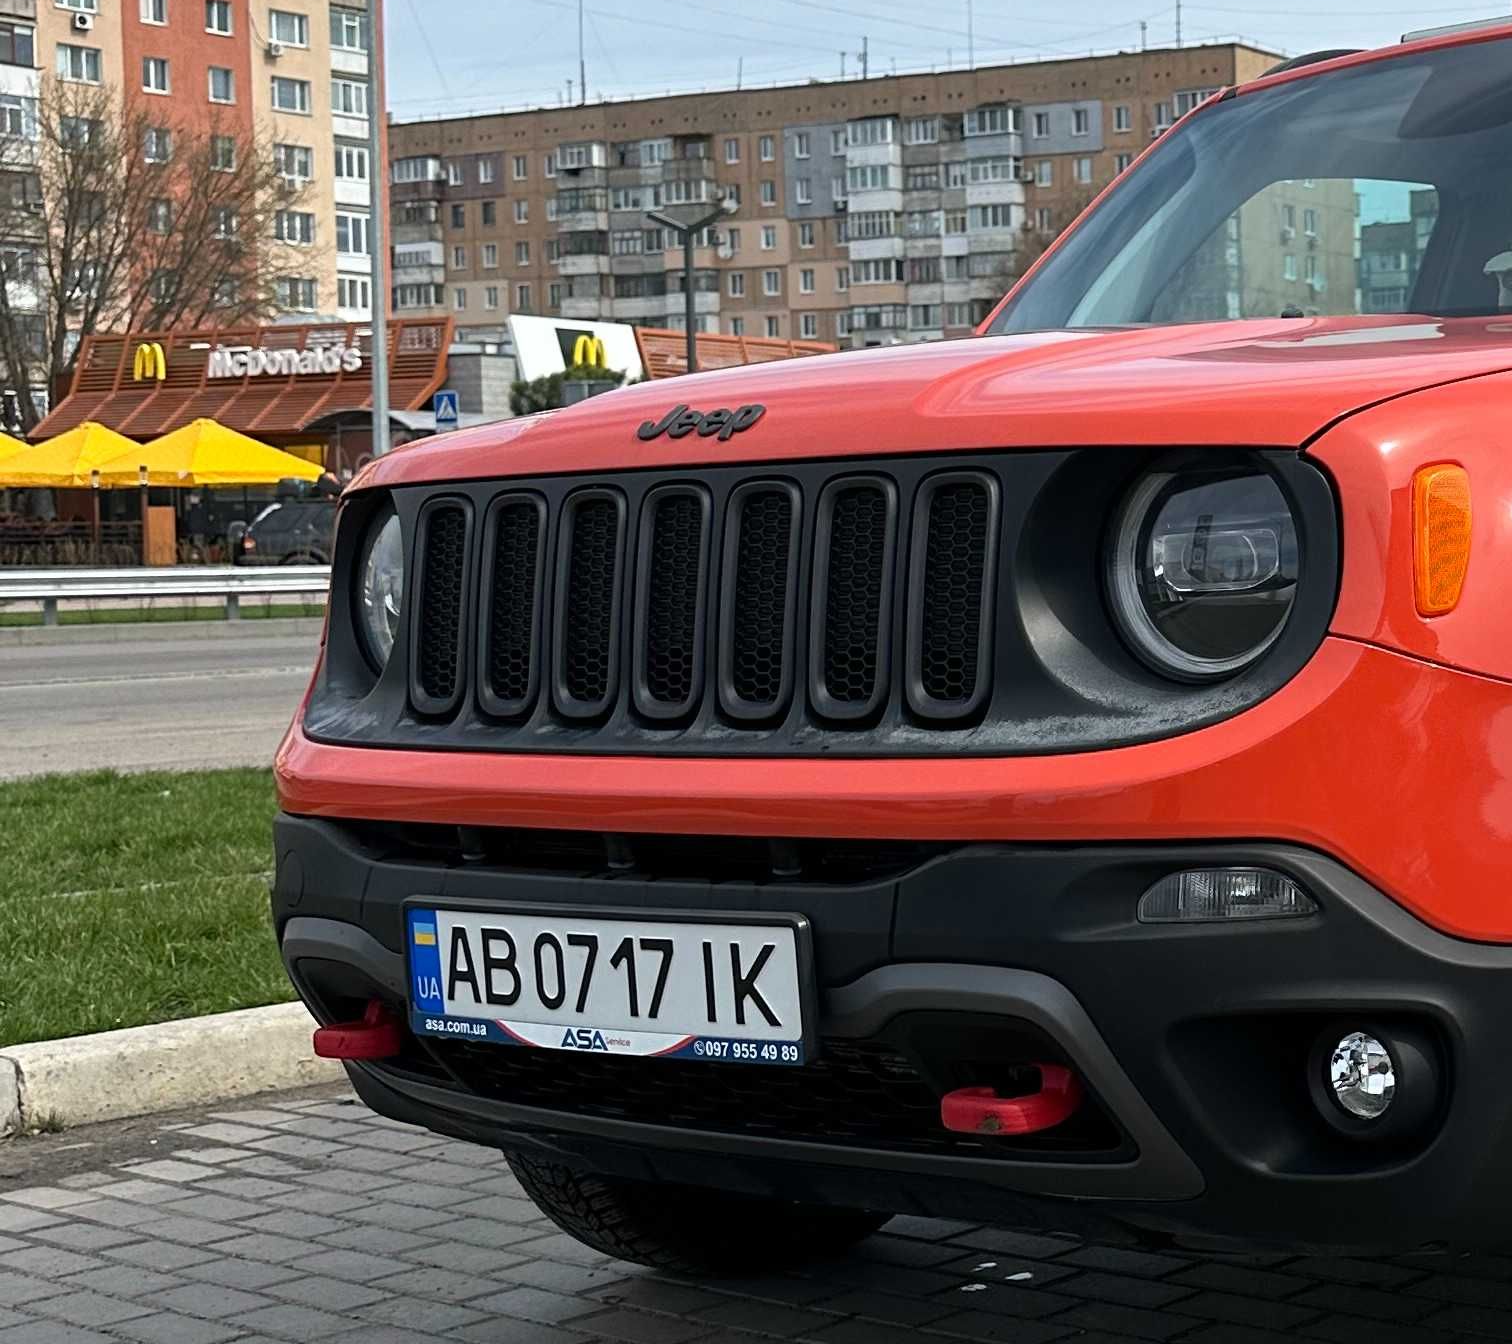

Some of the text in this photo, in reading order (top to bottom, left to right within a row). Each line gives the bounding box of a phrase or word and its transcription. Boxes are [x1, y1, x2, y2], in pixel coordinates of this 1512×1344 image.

[207, 345, 363, 379] McDonald's
[637, 404, 768, 442] Jeep
[417, 975, 441, 1001] UA
[447, 926, 783, 1027] AB 0717 IK
[425, 1017, 488, 1036] asa.com.ua
[561, 1027, 609, 1051] ASA
[705, 1040, 798, 1062] 097 955 49 89
